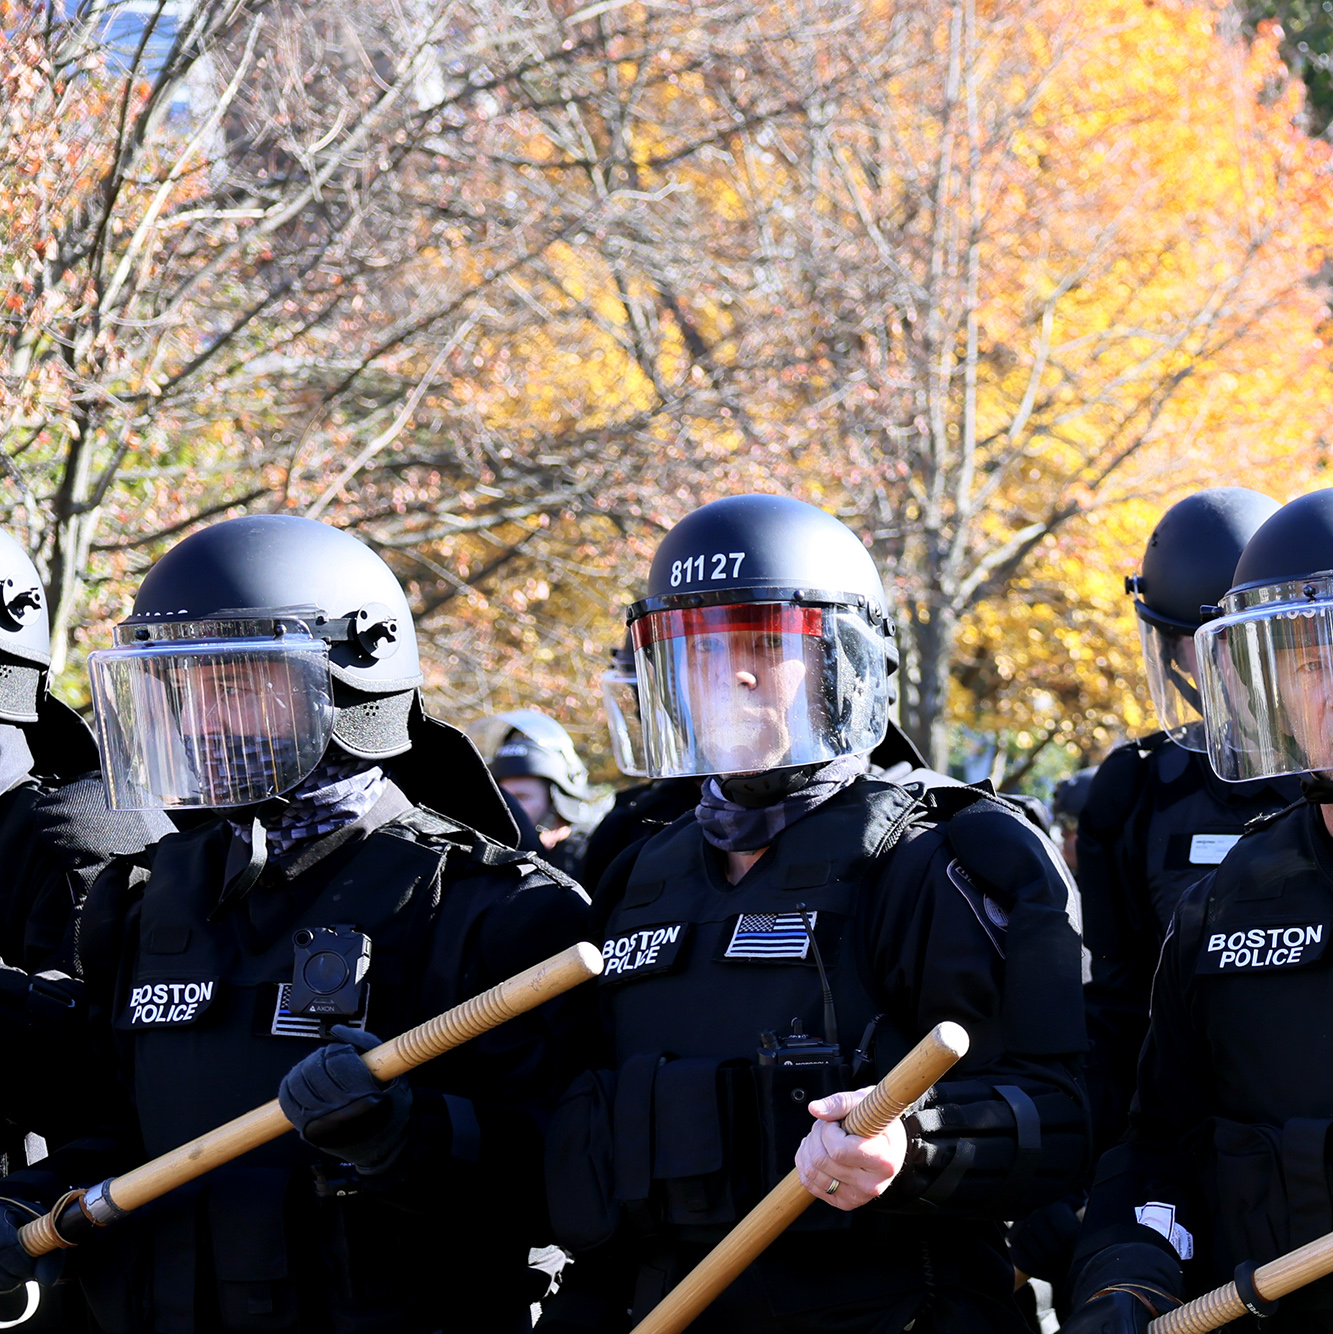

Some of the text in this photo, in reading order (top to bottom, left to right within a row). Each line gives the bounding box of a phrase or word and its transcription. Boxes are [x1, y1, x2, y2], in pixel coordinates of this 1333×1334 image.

[670, 552, 746, 588] 81127
[602, 924, 681, 959] BOSTON
[1207, 924, 1323, 952] BOSTON
[604, 945, 660, 977] POLICE
[1219, 946, 1306, 969] POLICE
[130, 981, 214, 1007] BOSTON
[131, 1002, 198, 1024] POLICE
